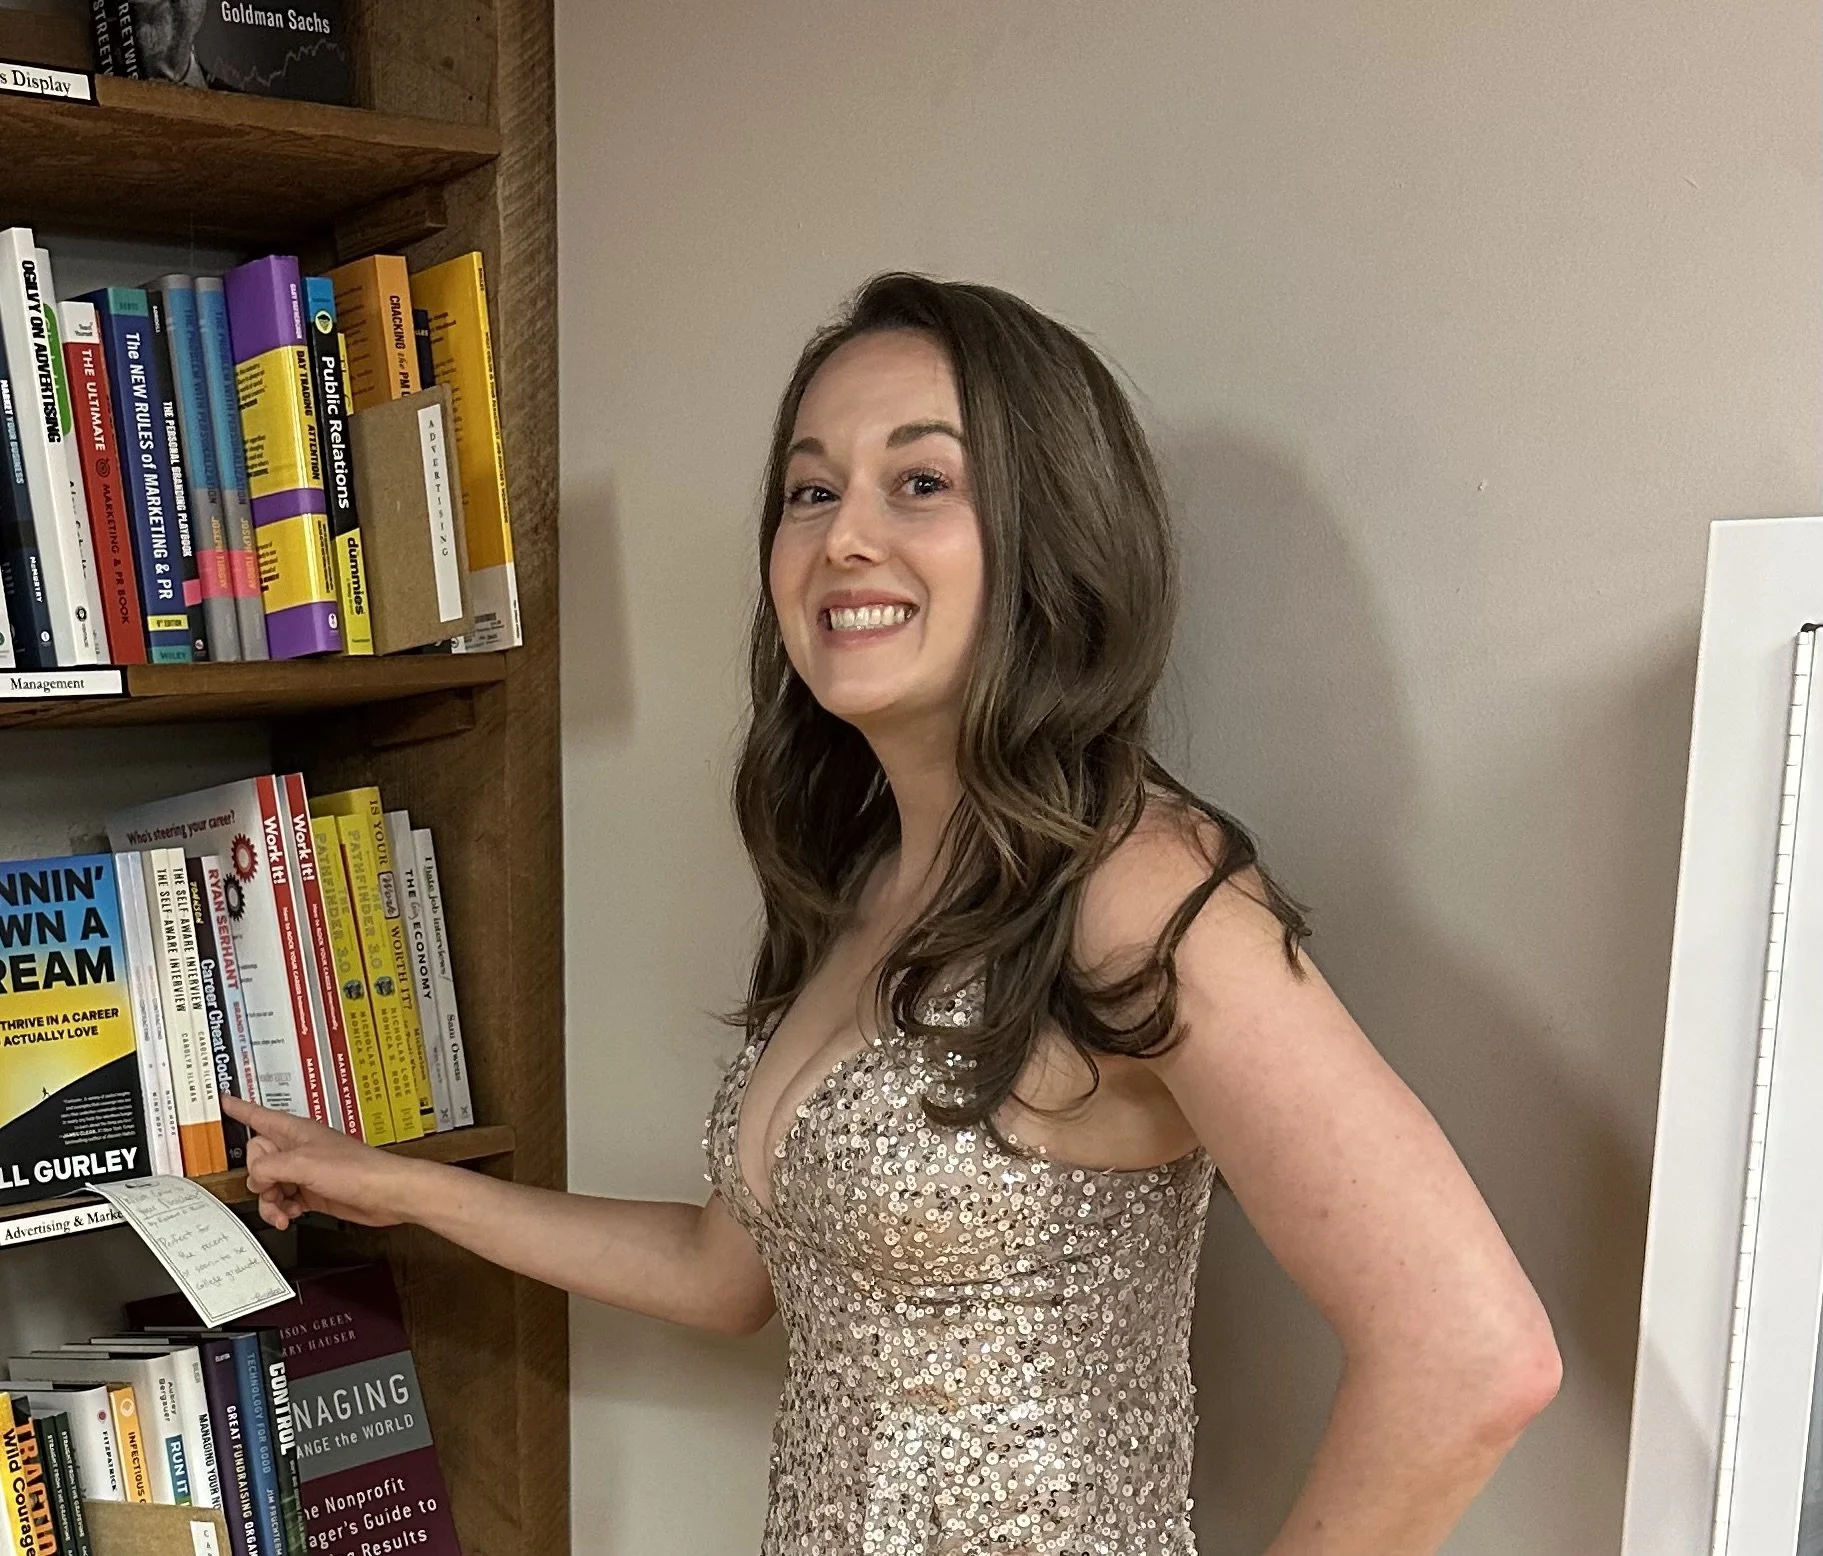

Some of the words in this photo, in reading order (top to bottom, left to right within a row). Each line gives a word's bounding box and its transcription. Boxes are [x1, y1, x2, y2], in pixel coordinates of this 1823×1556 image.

[221, 0, 284, 29] Goldman
[288, 9, 331, 34] Sachs
[12, 70, 71, 97] Display
[22, 260, 42, 314] OGILVY
[31, 316, 46, 338] ON
[390, 296, 406, 350] CRACKING
[82, 350, 95, 376] THE
[126, 332, 140, 360] The
[296, 350, 307, 370] DAY
[398, 353, 407, 370] the
[34, 342, 61, 444] ADVERTISING
[130, 364, 148, 399] NEW
[300, 372, 313, 416] TRADING
[322, 356, 340, 415] Public
[399, 372, 411, 390] PM
[87, 382, 106, 451] ULTIMATE
[134, 402, 154, 450] RULES
[163, 402, 174, 418] THE
[141, 454, 156, 470] of
[166, 420, 180, 465] PERSONAL
[308, 424, 322, 480] ATTENTION
[329, 420, 350, 509] Relations
[103, 484, 120, 554] MARKETING
[144, 474, 168, 558] MARKETING
[178, 512, 192, 558] PLAYBOOK
[114, 558, 122, 566] &
[115, 570, 124, 586] PR
[154, 563, 170, 574] &
[347, 538, 364, 615] dummies
[118, 588, 130, 624] BOOK
[157, 579, 174, 600] PR
[10, 678, 85, 692] Management
[127, 831, 153, 846] Who's
[153, 823, 188, 842] steering
[188, 819, 208, 837] your
[208, 810, 236, 828] career?
[369, 800, 380, 816] IS
[264, 816, 284, 863] Work
[293, 814, 312, 860] Work
[373, 822, 390, 866] YOUR
[208, 868, 225, 912] RYAN
[272, 865, 288, 885] It!
[301, 862, 316, 882] It!
[314, 834, 344, 940] PATHFINDER
[348, 830, 376, 937] PATHFINDER
[382, 875, 398, 915] Work
[80, 906, 110, 940] A
[156, 868, 168, 886] THE
[169, 958, 186, 1012] INTERVIEW
[172, 868, 185, 886] THE
[184, 956, 202, 1010] INTERVIEW
[405, 868, 416, 898] THE
[414, 922, 432, 1000] ECONOMY
[216, 916, 238, 990] SERHANT
[392, 926, 408, 984] WORTH
[201, 959, 218, 1008] Career
[400, 988, 412, 1010] IT?
[428, 894, 439, 914] job
[447, 1014, 456, 1040] Sam
[452, 1043, 462, 1081] Owens
[0, 1016, 44, 1031] THRIVE
[46, 1014, 59, 1026] IN
[60, 1012, 72, 1024] A
[72, 1008, 120, 1022] CAREER
[4, 1030, 65, 1047] ACTUALLY
[67, 1026, 99, 1040] LOVE
[208, 1010, 226, 1052] Cheat
[234, 1002, 244, 1034] BRAND
[238, 1034, 246, 1043] IT
[240, 1046, 250, 1066] LIKE
[336, 1053, 348, 1086] MARIA
[350, 1012, 363, 1054] MONICA
[362, 1074, 372, 1102] ROSE
[359, 1010, 376, 1067] NICHOLAS
[370, 1072, 382, 1100] LORE
[380, 1008, 393, 1050] MONICA
[391, 1070, 402, 1098] ROSE
[391, 1007, 406, 1063] NICHOLAS
[401, 1068, 412, 1096] LORE
[306, 1058, 318, 1090] MARIA
[343, 1088, 357, 1134] KYRIAKOS
[34, 1146, 138, 1184] GURLEY
[5, 1218, 70, 1242] Advertising
[74, 1214, 84, 1226] &
[158, 1230, 193, 1250] Perfect
[308, 1330, 357, 1352] HAUSER
[312, 1312, 353, 1332] GREEN
[158, 1378, 170, 1422] Bergauer
[168, 1382, 176, 1415] Aubrey
[246, 1352, 264, 1420] TECHNOLOGY
[292, 1373, 410, 1432] NAGING
[226, 1405, 241, 1440] GREAT
[270, 1362, 296, 1456] CONTROL
[3, 1428, 22, 1474] Wild
[256, 1422, 268, 1442] FOR
[296, 1435, 330, 1460] ANGE
[334, 1426, 358, 1448] the
[361, 1412, 414, 1438] WORLD
[102, 1430, 118, 1492] FITZPATRICK
[128, 1432, 146, 1497] INFECTIOUS
[170, 1441, 185, 1476] RUN
[198, 1413, 214, 1467] MANAGING
[208, 1468, 220, 1496] YOUR
[260, 1446, 272, 1474] GOOD
[176, 1480, 189, 1494] IT
[232, 1444, 252, 1518] FUNDRAISING
[324, 1477, 406, 1514] Nonprofit
[12, 1476, 36, 1556] Courage
[308, 1520, 358, 1550] ager's
[363, 1504, 412, 1531] Guide
[418, 1498, 437, 1514] to
[361, 1528, 428, 1556] Results
